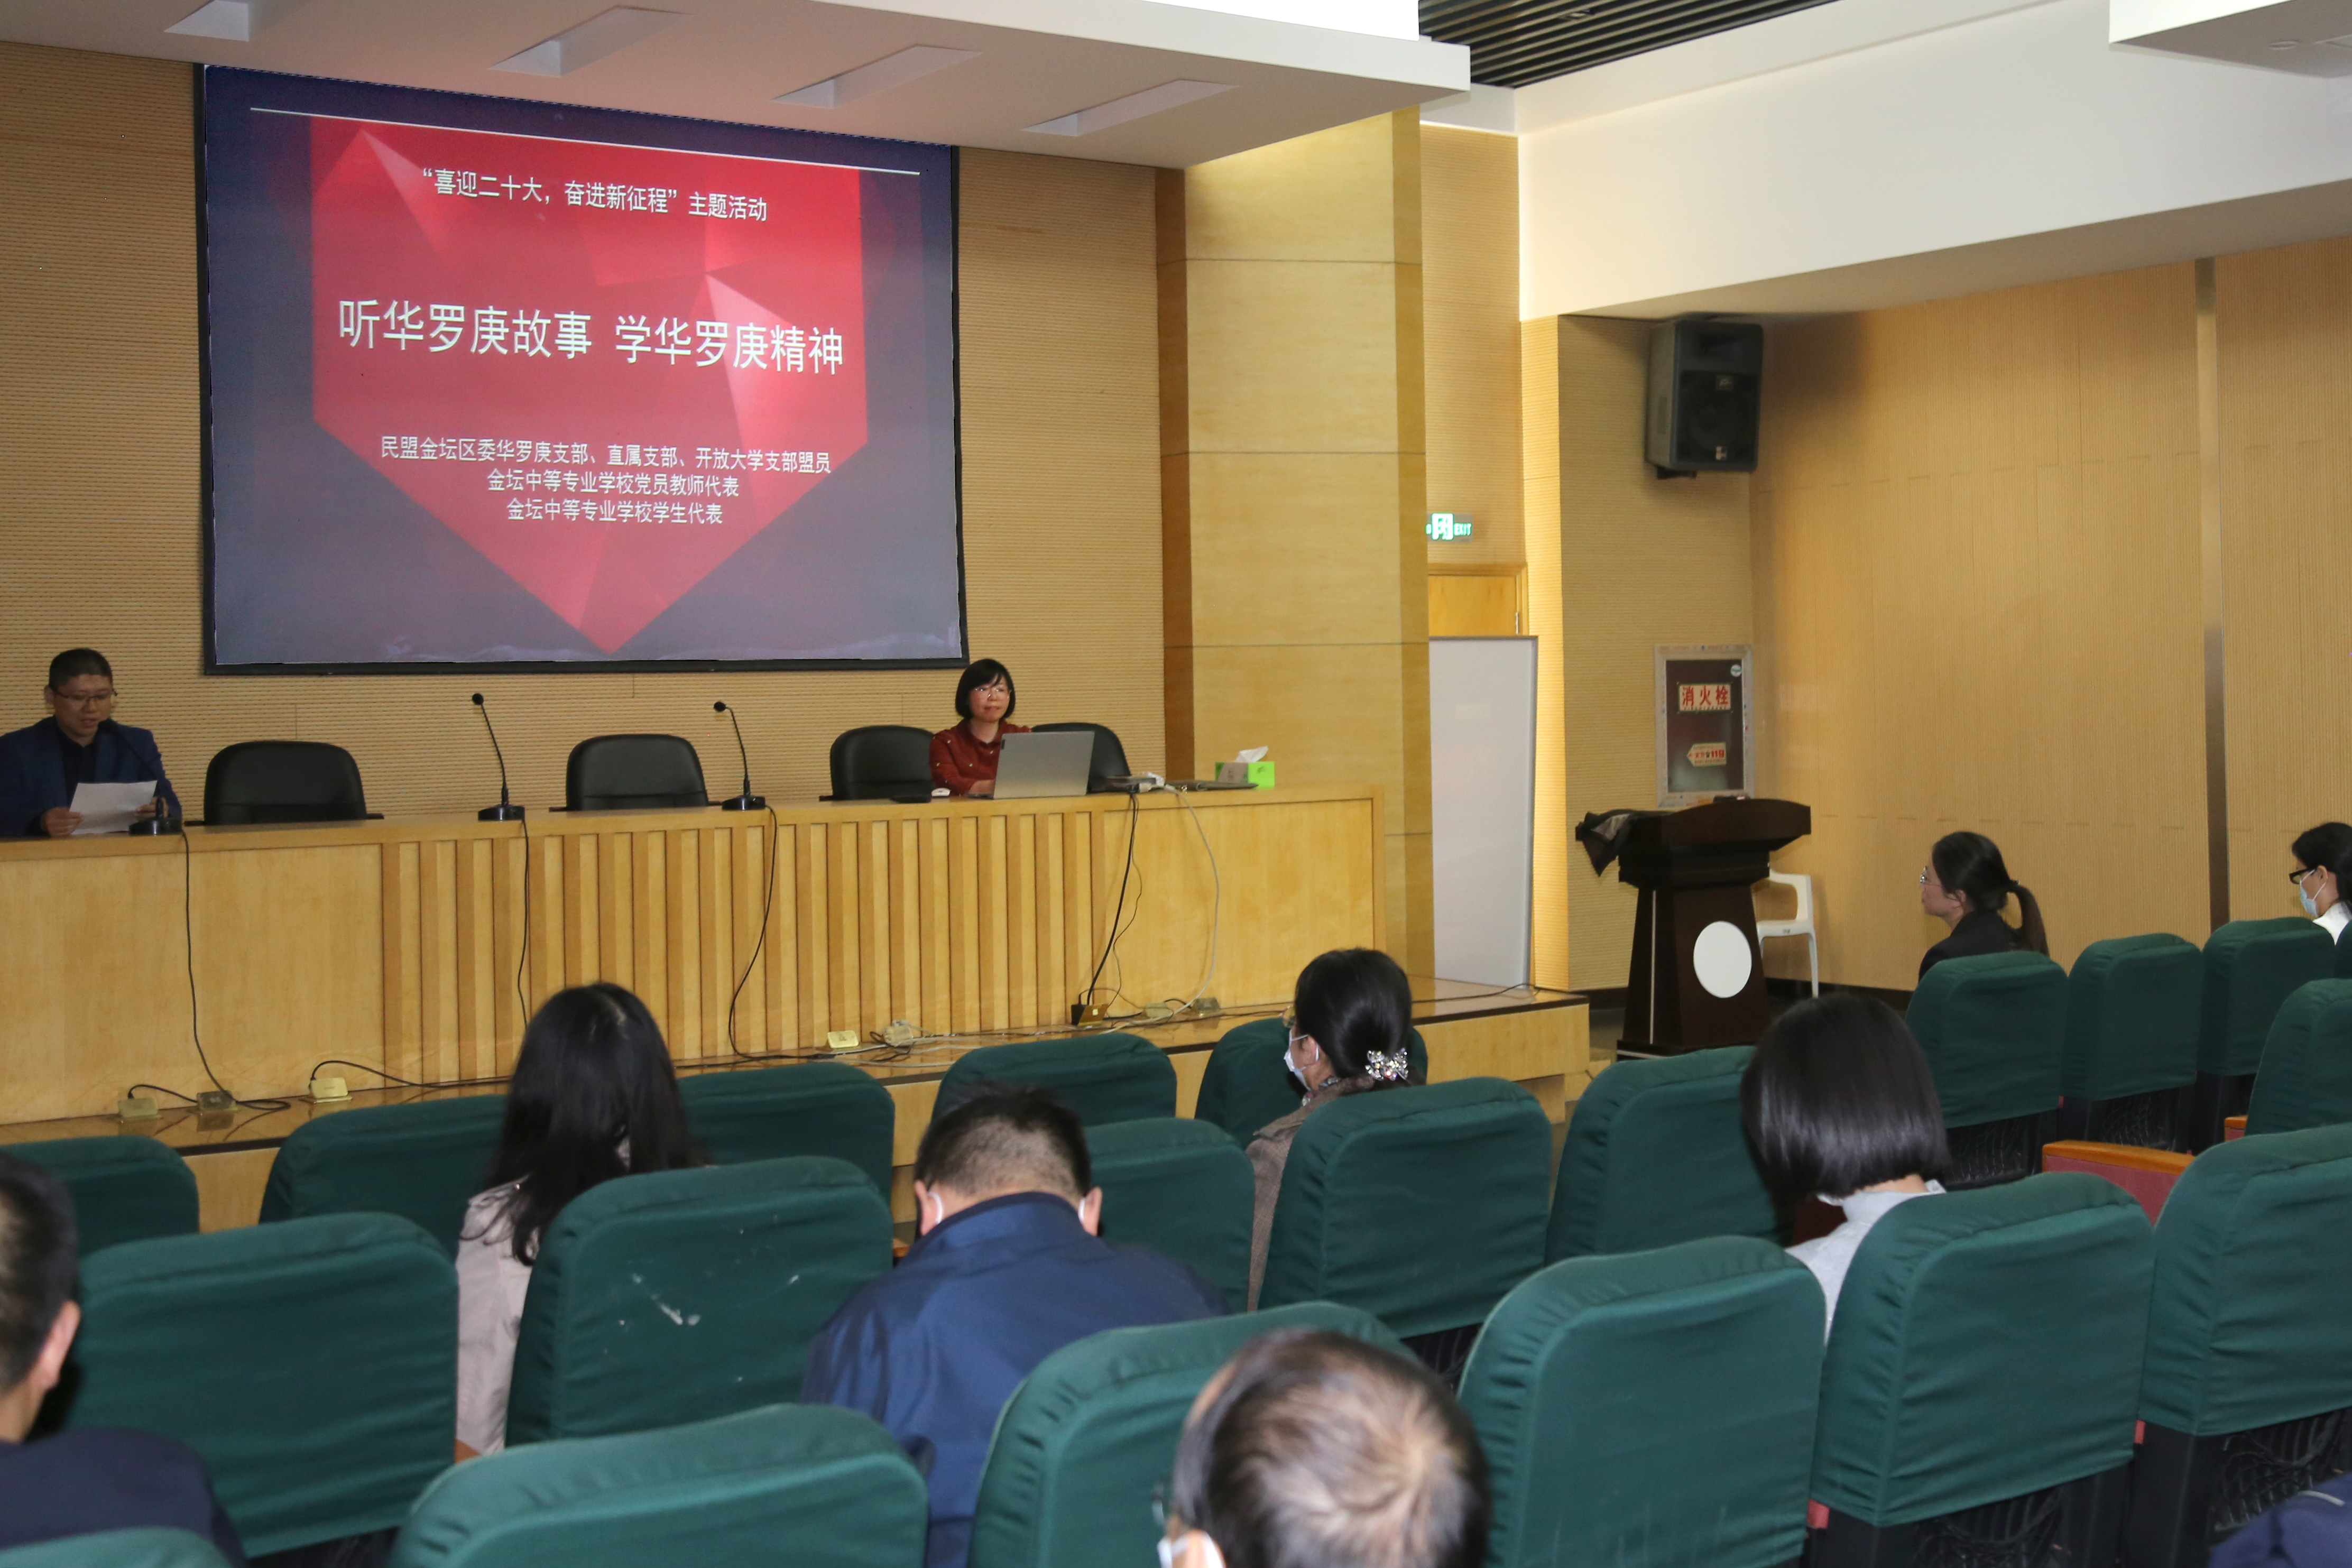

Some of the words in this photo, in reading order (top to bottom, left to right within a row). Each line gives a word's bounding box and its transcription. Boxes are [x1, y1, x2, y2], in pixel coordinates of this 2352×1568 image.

[688, 191, 767, 222] 主题活动
[339, 299, 592, 359] 听华罗庚故事
[615, 315, 843, 375] 学华罗庚精神
[487, 468, 739, 497] 金坛中等专业学校党员教师代表
[506, 497, 723, 524] 金坛中等专业学校学生代表
[1454, 523, 1472, 536] EXIT
[1682, 685, 1729, 707] 消火栓
